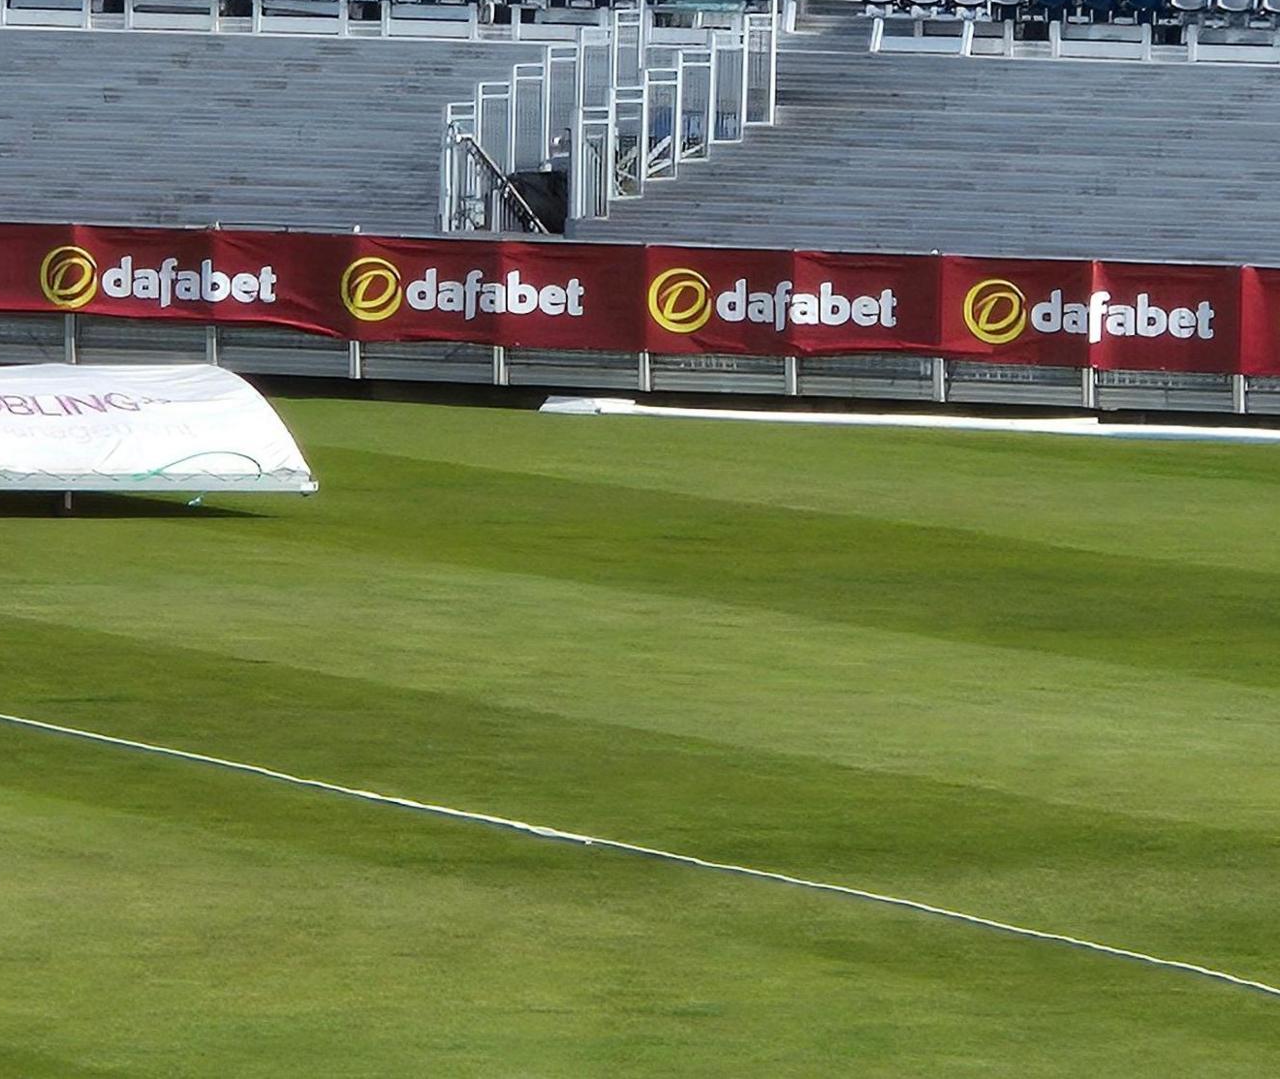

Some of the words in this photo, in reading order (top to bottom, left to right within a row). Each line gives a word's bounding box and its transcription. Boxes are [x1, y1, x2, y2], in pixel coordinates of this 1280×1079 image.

[102, 256, 276, 307] dafabet
[406, 268, 584, 319] dafabet
[716, 279, 897, 331] dafabet
[1031, 290, 1214, 343] dafabet
